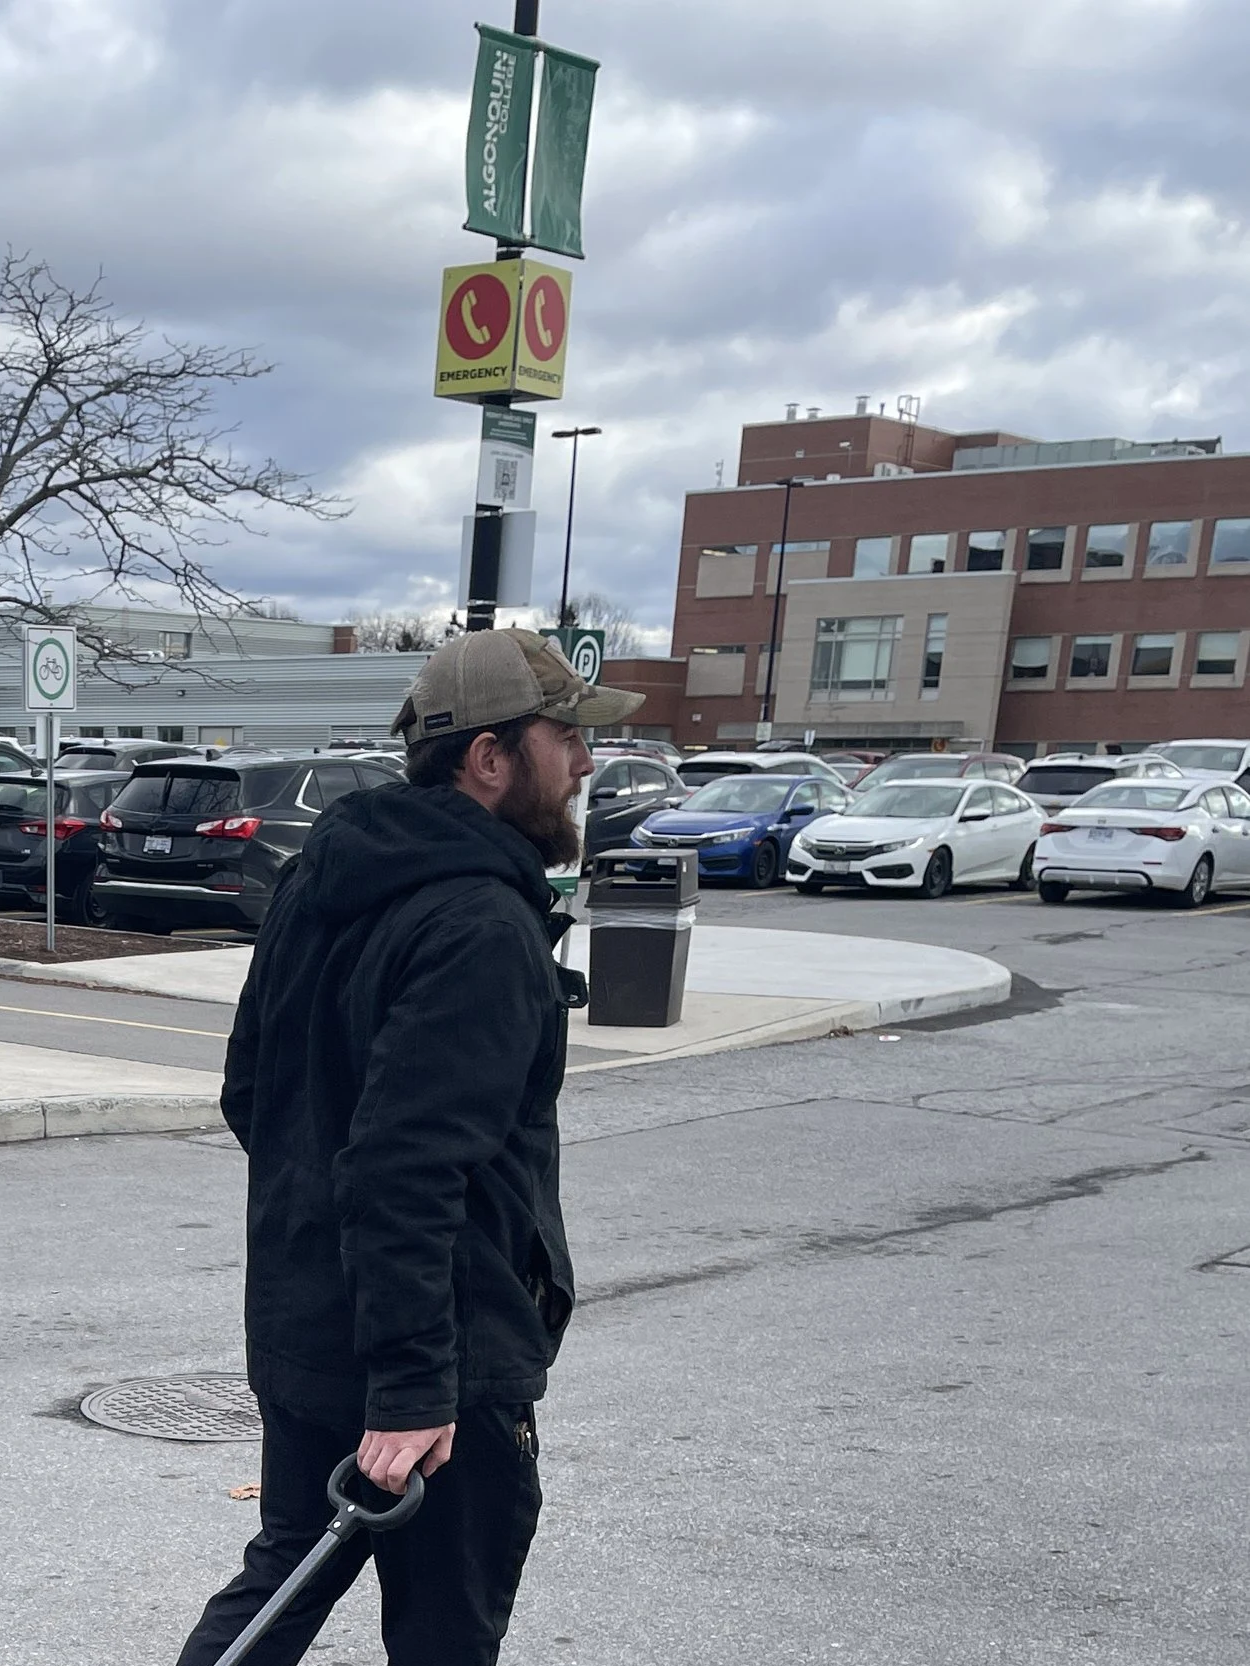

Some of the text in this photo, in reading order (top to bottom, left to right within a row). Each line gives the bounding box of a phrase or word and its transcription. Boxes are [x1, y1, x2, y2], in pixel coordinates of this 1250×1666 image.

[499, 52, 517, 134] COLLEGE
[482, 49, 509, 216] ALGONQUIN
[439, 366, 508, 382] EMERGENCY
[518, 365, 562, 384] EMERGENCY
[582, 653, 591, 673] P
